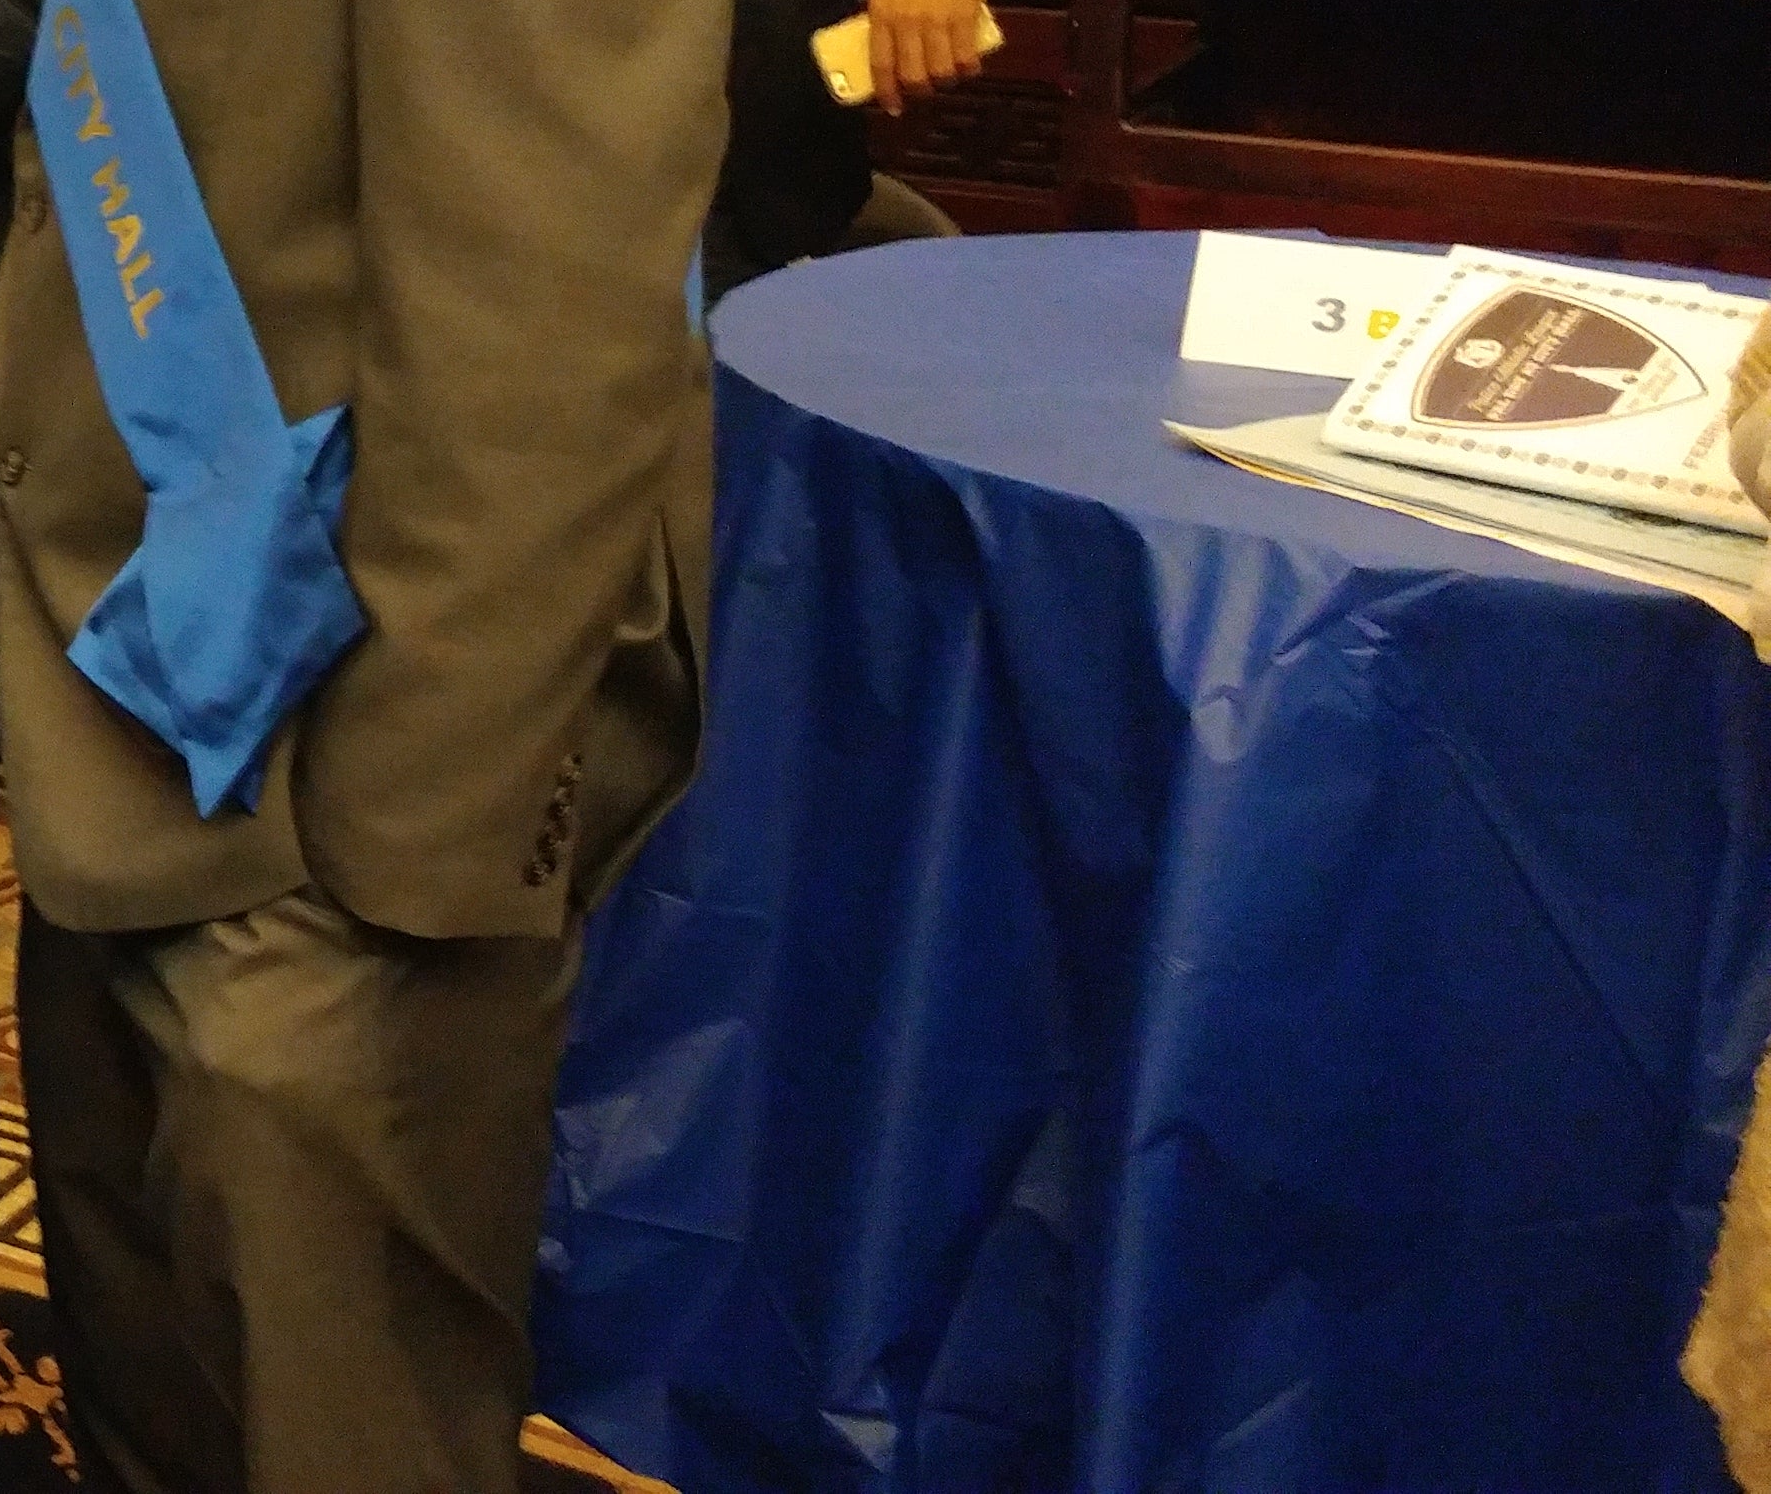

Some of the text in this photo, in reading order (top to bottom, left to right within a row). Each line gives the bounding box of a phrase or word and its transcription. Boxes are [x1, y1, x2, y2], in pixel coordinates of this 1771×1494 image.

[54, 6, 115, 143] CITY
[91, 156, 164, 340] HALL
[1312, 297, 1347, 333] 3
